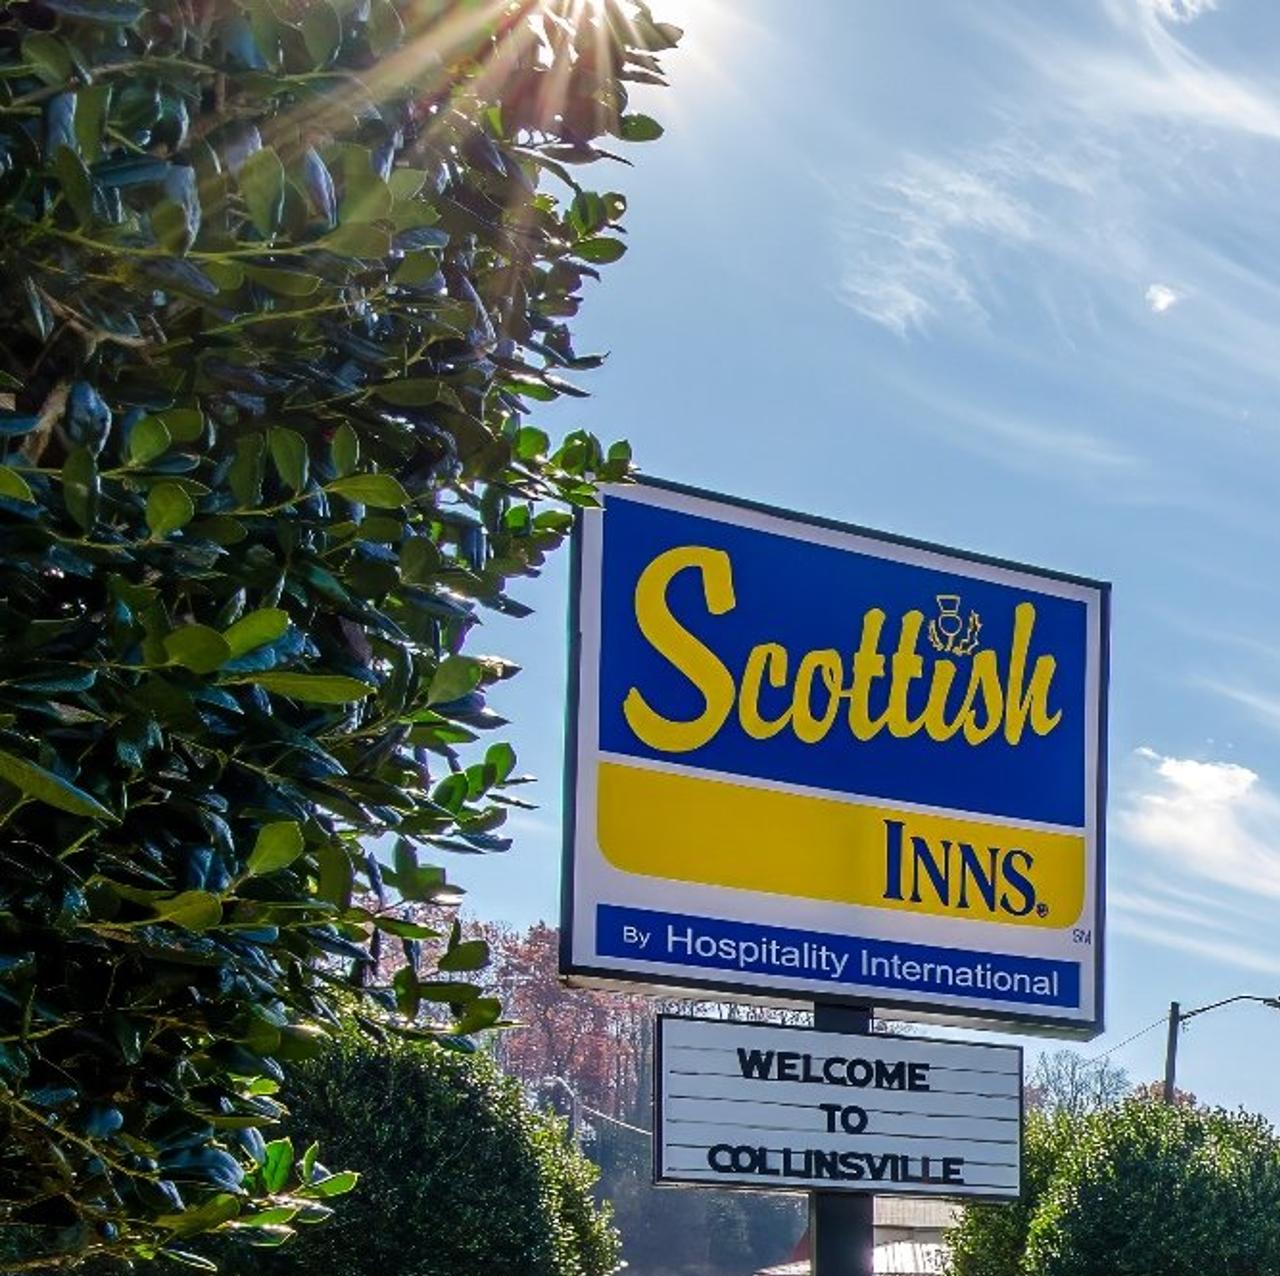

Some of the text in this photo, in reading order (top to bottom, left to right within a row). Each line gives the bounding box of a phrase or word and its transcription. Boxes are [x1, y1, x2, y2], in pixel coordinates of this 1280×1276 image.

[622, 545, 1063, 753] Scottish
[623, 924, 1059, 998] By Hospitality International
[736, 1047, 931, 1092] WELCOME
[819, 1103, 869, 1135] TO
[707, 1143, 965, 1185] COLLINSVILLE
